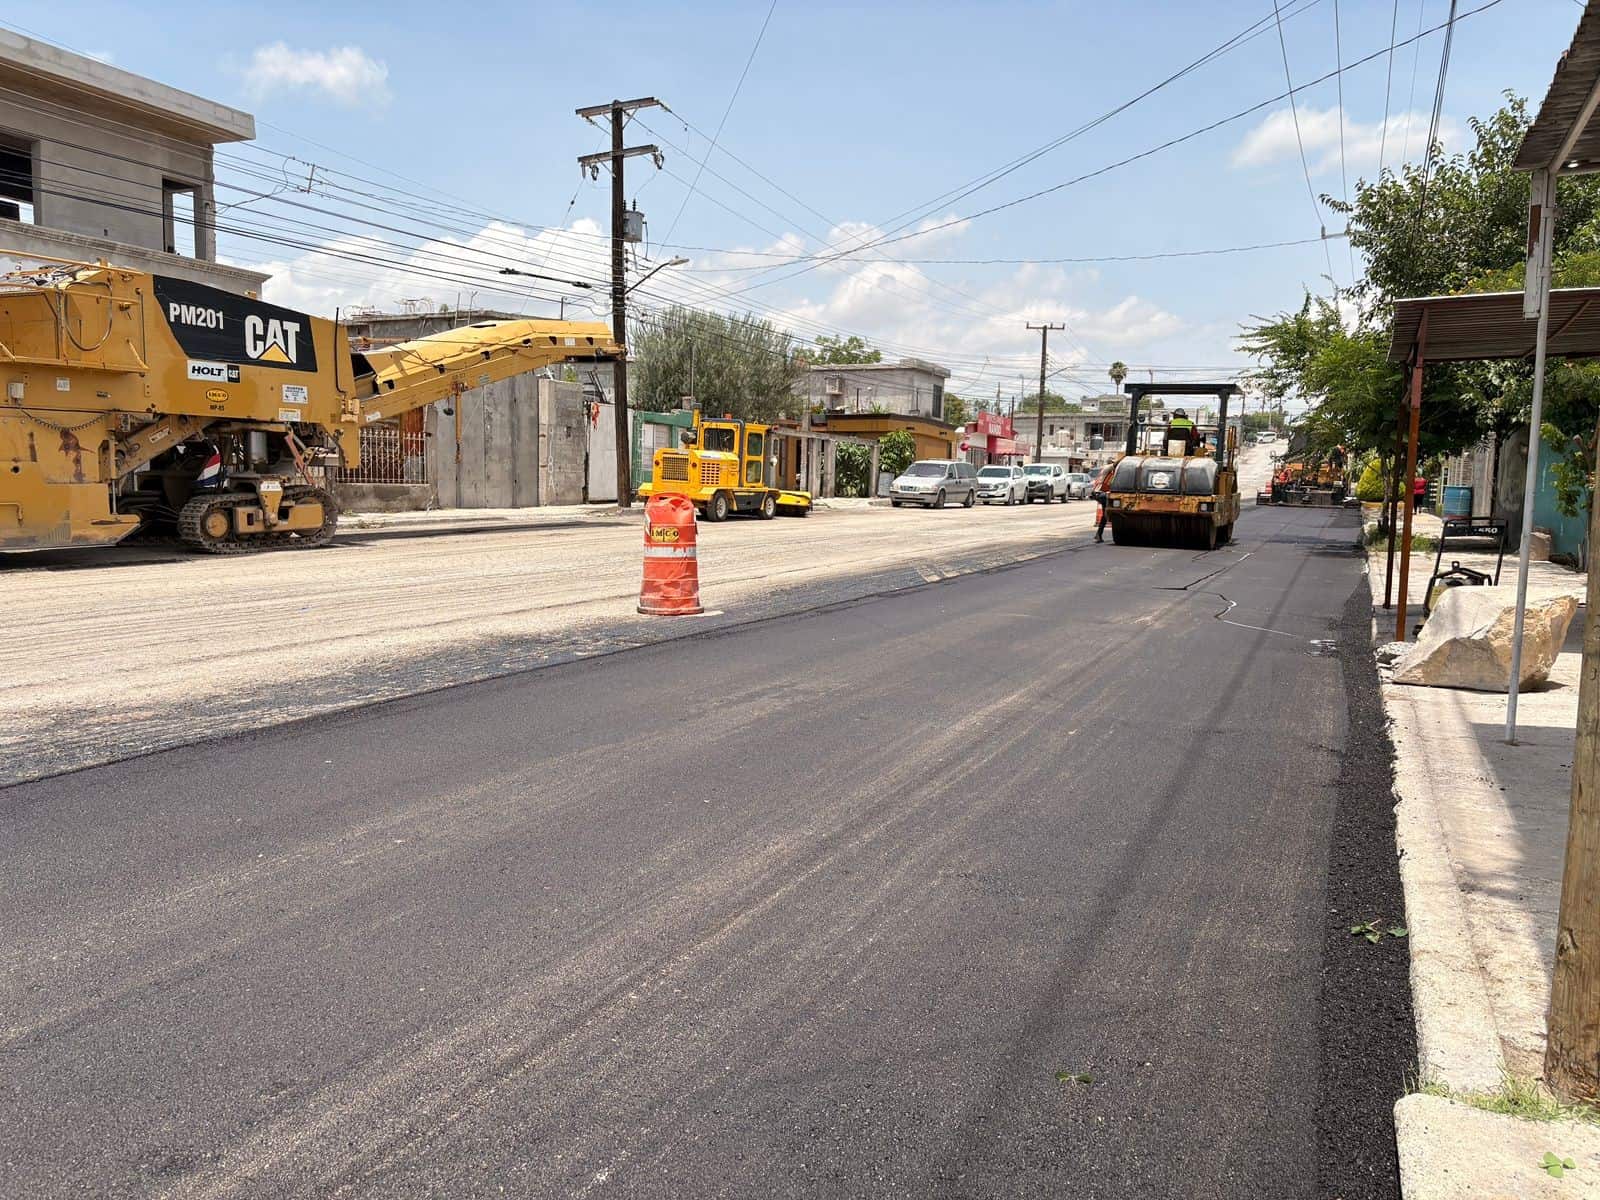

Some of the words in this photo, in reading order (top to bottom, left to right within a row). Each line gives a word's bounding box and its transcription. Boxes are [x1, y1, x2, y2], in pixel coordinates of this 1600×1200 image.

[169, 302, 224, 329] PM201
[244, 314, 300, 364] CAT
[191, 365, 224, 377] HOLT
